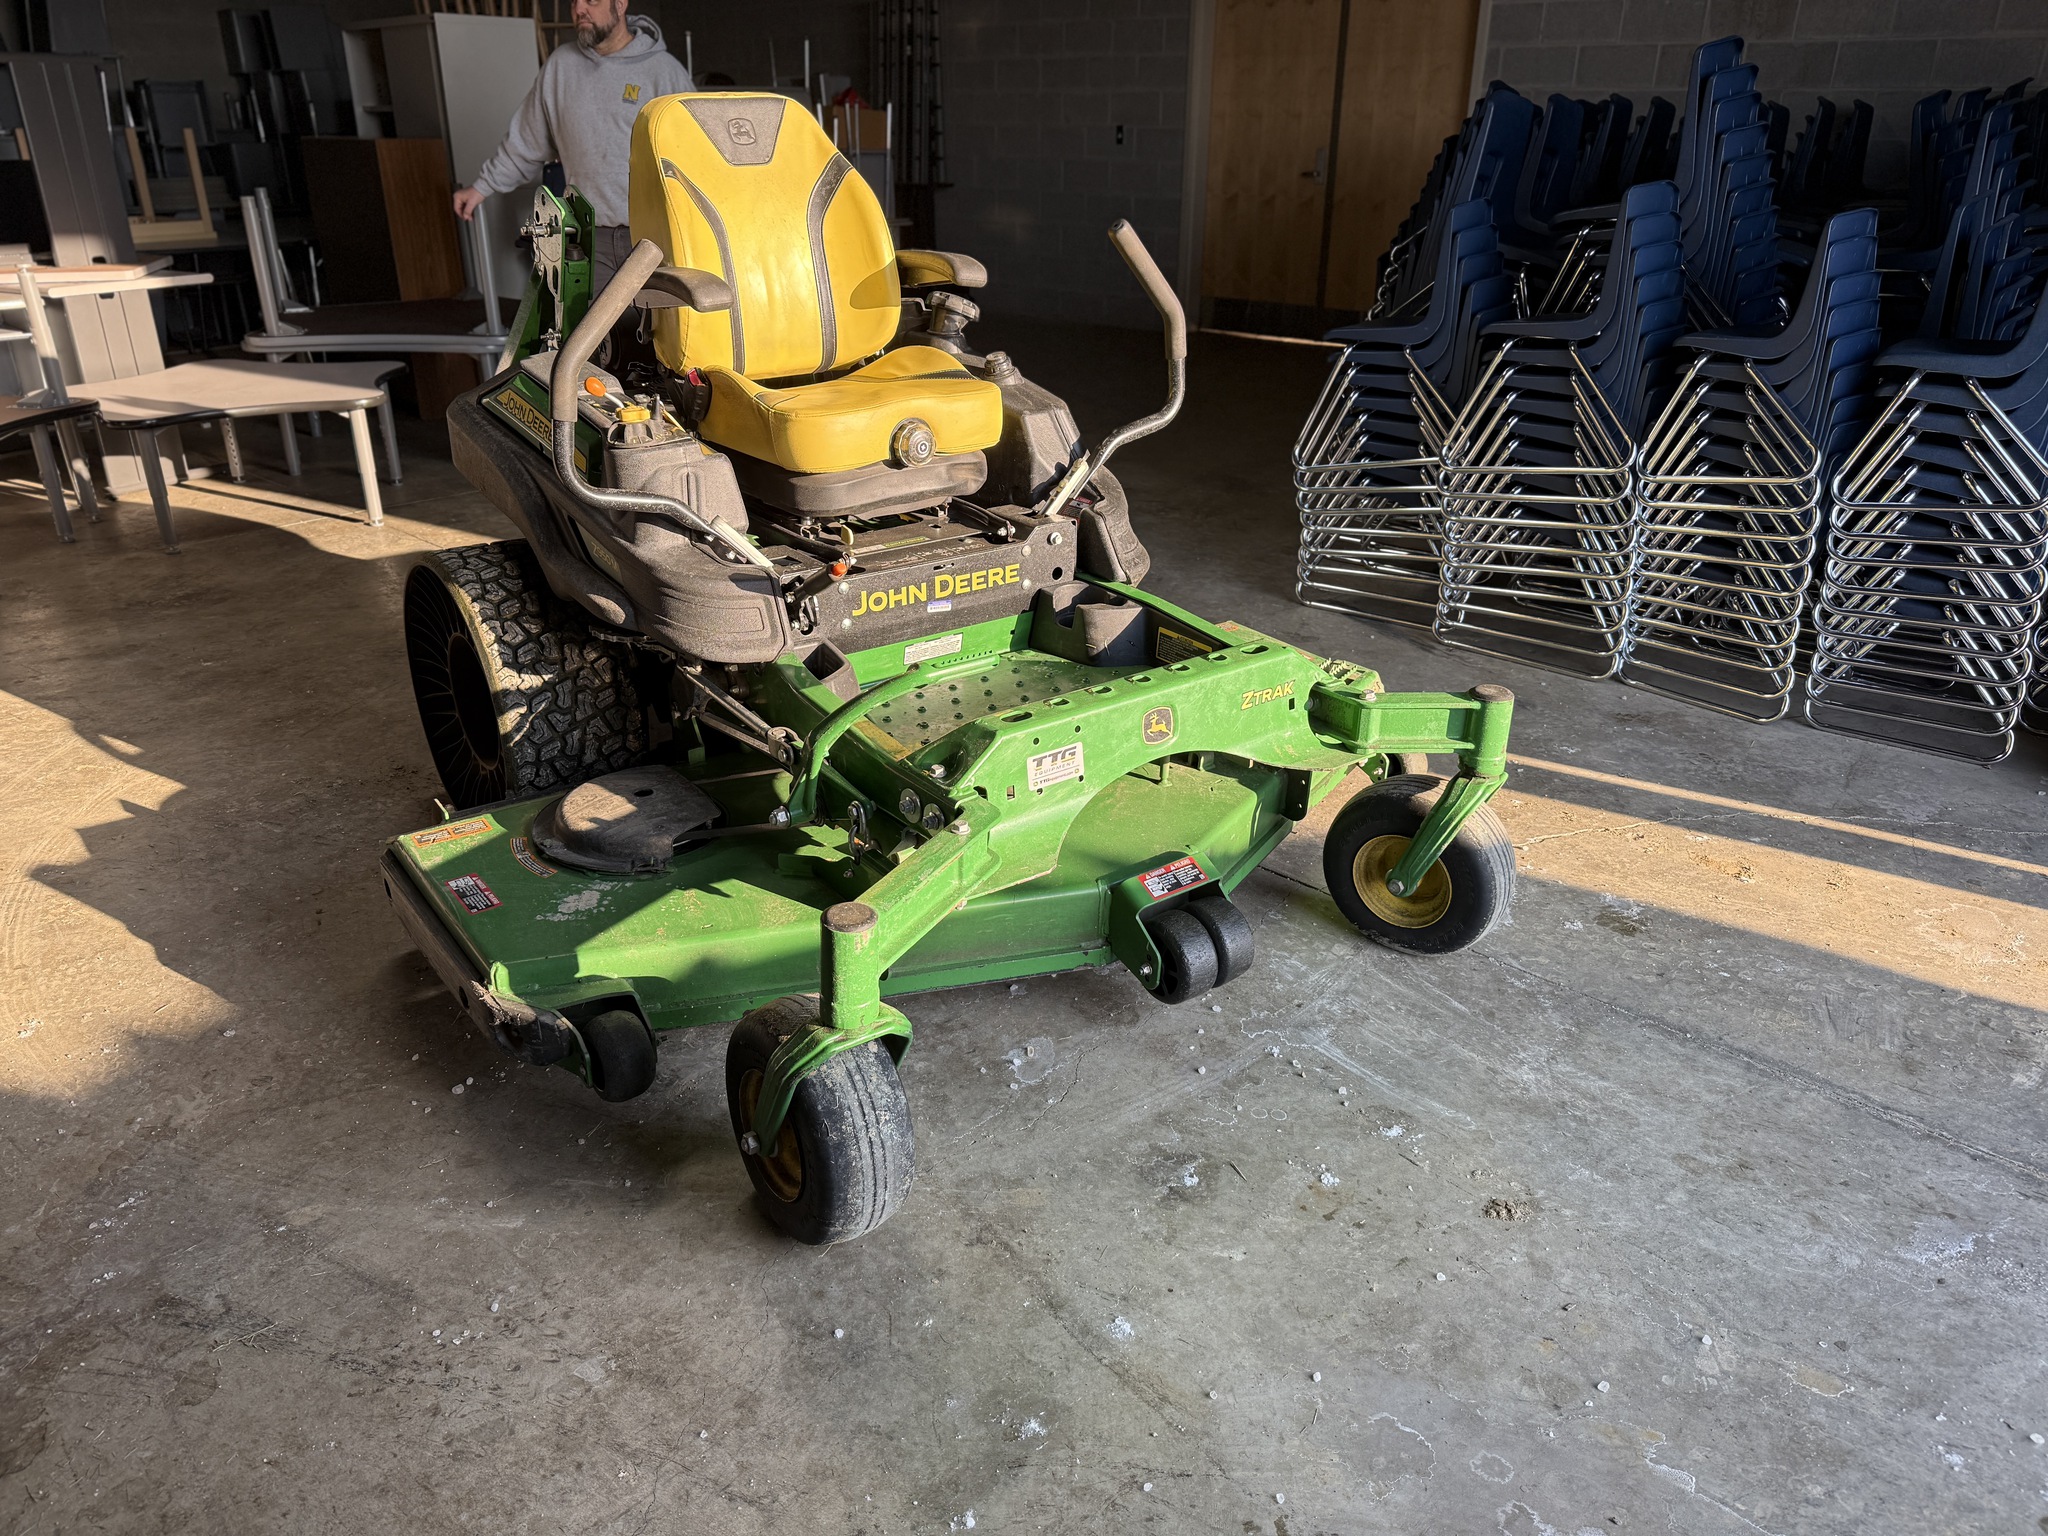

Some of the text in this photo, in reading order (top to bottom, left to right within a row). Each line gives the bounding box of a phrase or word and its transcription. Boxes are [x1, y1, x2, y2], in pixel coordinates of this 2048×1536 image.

[622, 84, 641, 101] N
[503, 393, 526, 422] JOHN
[852, 563, 1020, 616] JOHN DEERE
[1241, 680, 1296, 710] ZTRAK
[1032, 746, 1077, 770] TTG
[1034, 761, 1075, 777] EQUIPMENT
